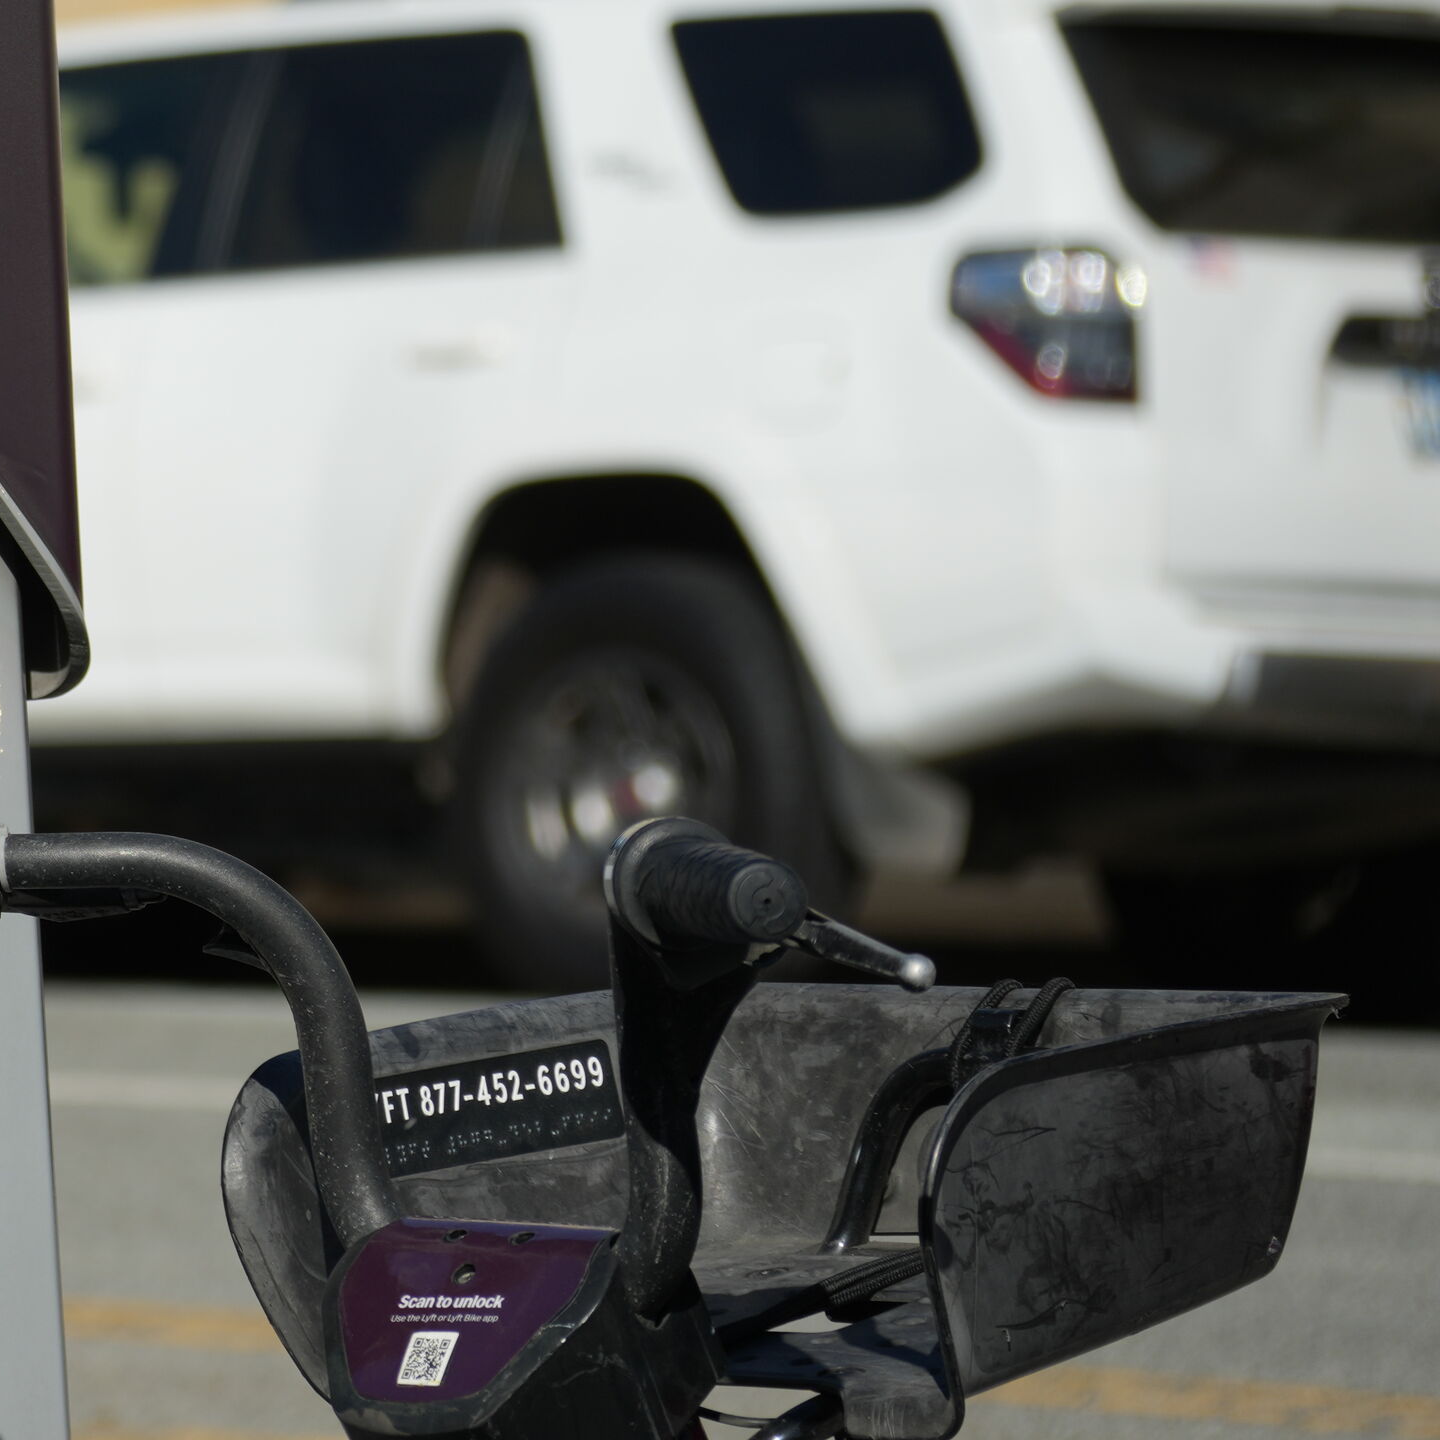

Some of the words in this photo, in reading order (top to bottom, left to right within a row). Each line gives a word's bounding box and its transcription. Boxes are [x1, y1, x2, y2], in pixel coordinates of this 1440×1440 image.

[375, 1087, 410, 1124] FT
[419, 1056, 604, 1117] 877-452-6699
[398, 1294, 436, 1309] Scan
[436, 1295, 453, 1309] to
[453, 1295, 505, 1309] unlock
[390, 1314, 407, 1323] Use
[407, 1314, 421, 1323] the
[421, 1313, 438, 1324] Lyft
[437, 1315, 447, 1323] or
[447, 1313, 462, 1324] Lyft
[464, 1313, 482, 1323] Bike
[482, 1314, 499, 1324] app
